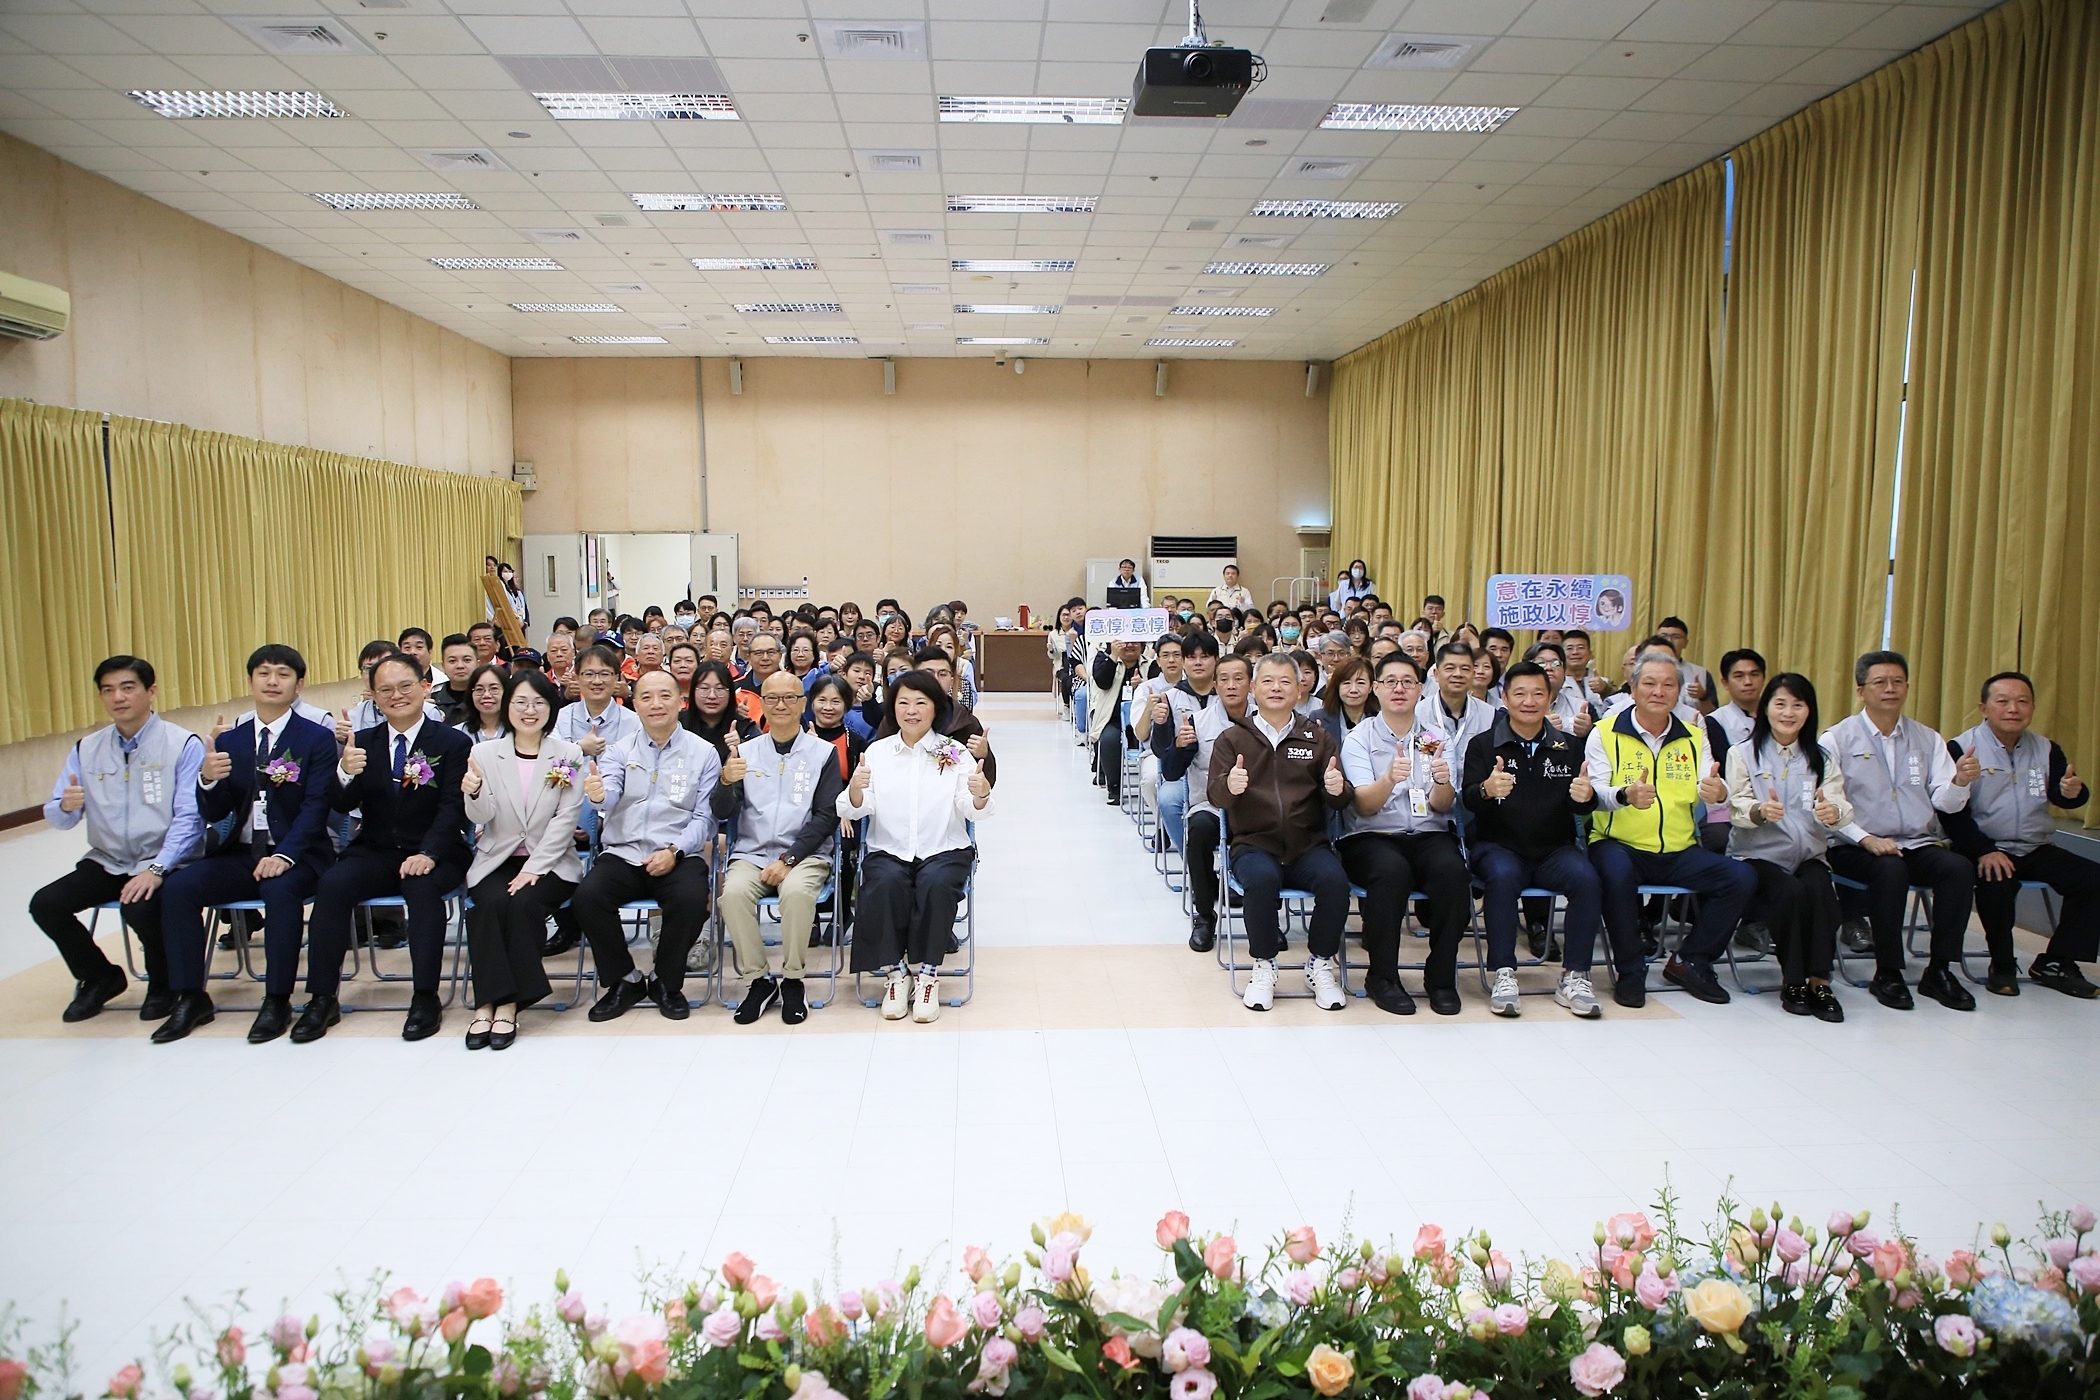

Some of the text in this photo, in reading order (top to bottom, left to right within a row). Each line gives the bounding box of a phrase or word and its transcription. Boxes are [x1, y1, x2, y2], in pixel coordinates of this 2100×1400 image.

[1496, 579, 1592, 601] 意在永續
[1499, 603, 1592, 625] 施政以惇
[1908, 755, 1921, 786] 林建宏
